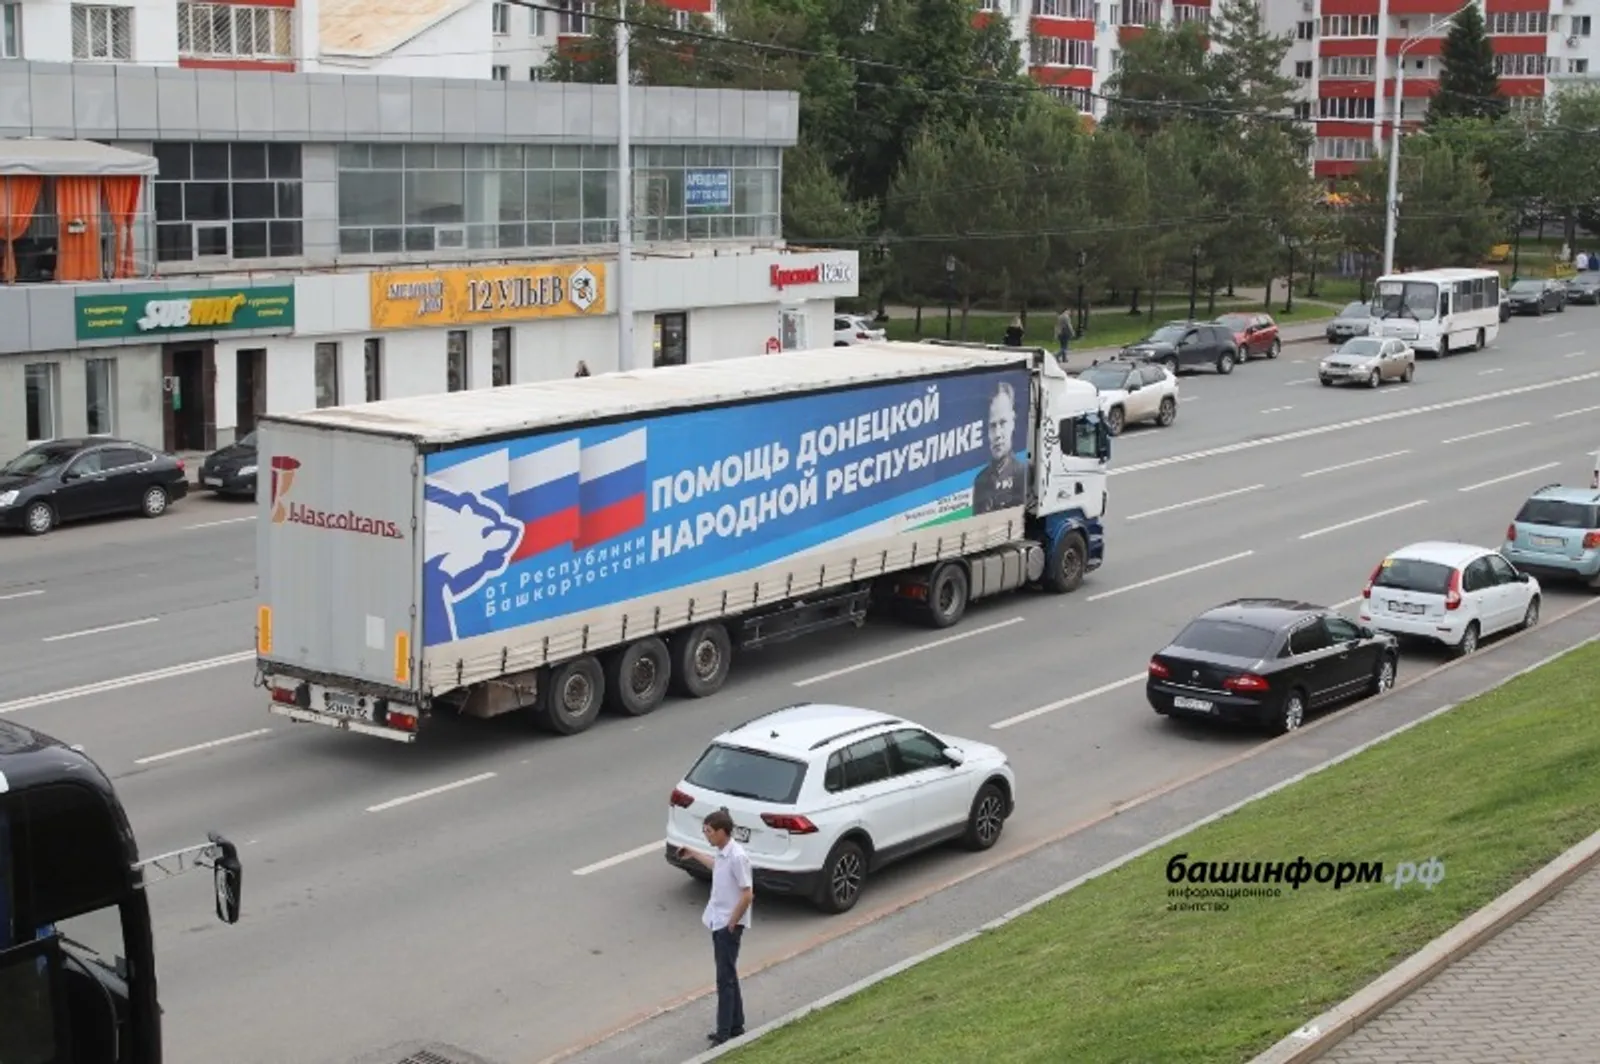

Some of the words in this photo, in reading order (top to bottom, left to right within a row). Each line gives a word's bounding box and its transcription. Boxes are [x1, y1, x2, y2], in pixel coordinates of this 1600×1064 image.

[137, 292, 247, 331] SUBWAY
[468, 279, 494, 312] 12
[496, 275, 564, 309] УЛЬЕВ
[652, 441, 790, 512] ПОМОЩЬ
[796, 385, 940, 471] ДОНЕЦКОЙ
[651, 469, 819, 562] НАРОДНОЙ
[826, 420, 984, 501] РЕСПУБЛИКЕ
[486, 552, 646, 617] Башкортостан
[486, 582, 508, 599] от
